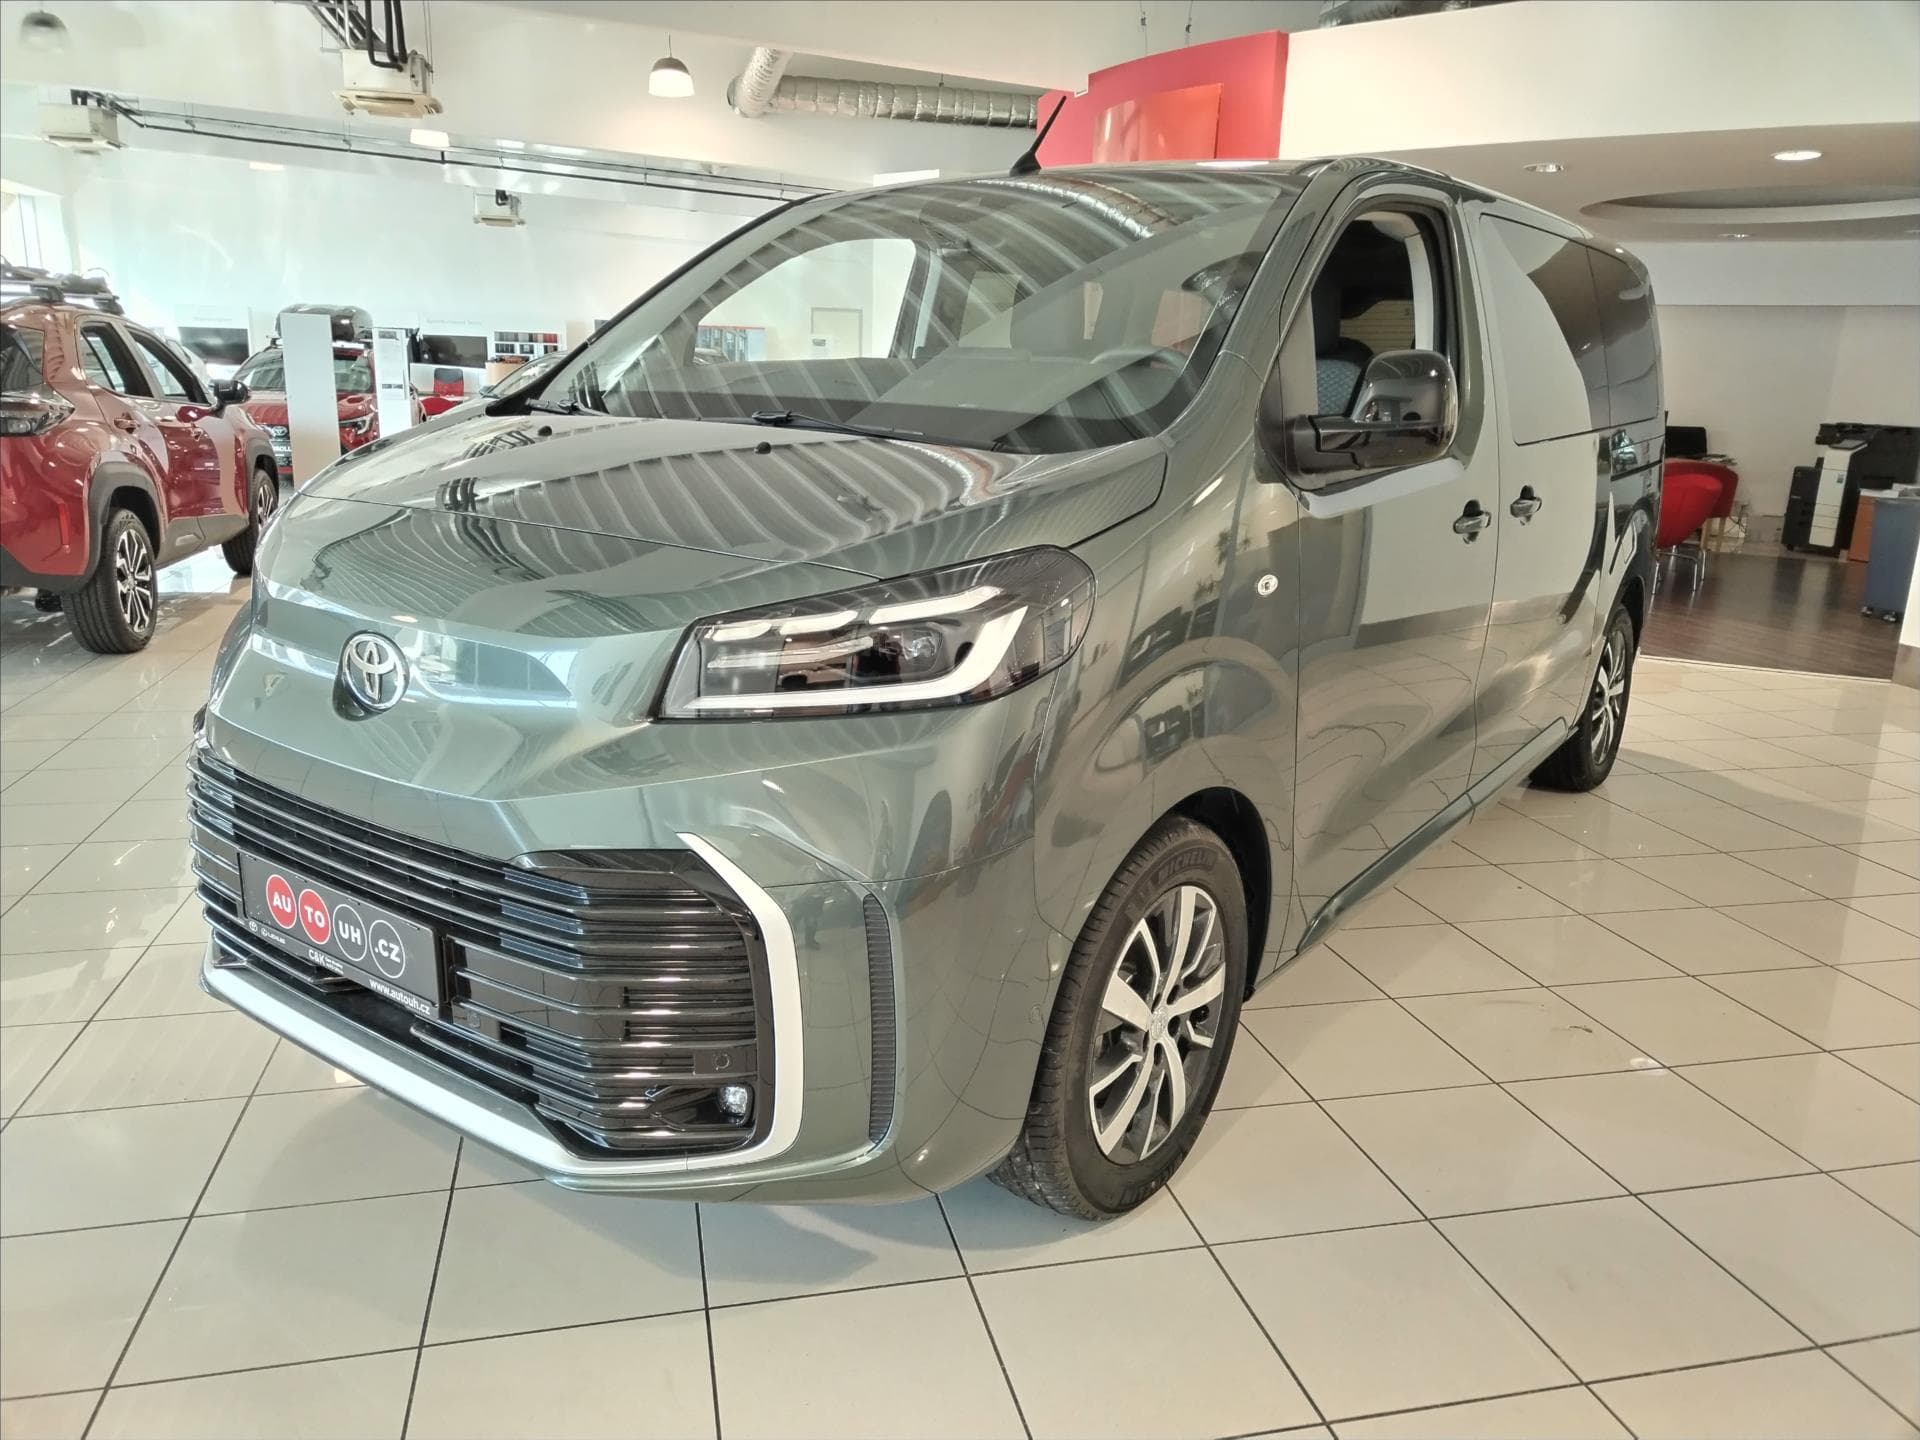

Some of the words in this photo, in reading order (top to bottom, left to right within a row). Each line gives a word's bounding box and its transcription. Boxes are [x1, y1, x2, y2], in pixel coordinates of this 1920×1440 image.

[272, 891, 292, 913] AU
[304, 905, 326, 928] TO
[338, 920, 362, 945] UH
[308, 949, 326, 966] C&K
[369, 978, 431, 1015] www.autouh.cz
